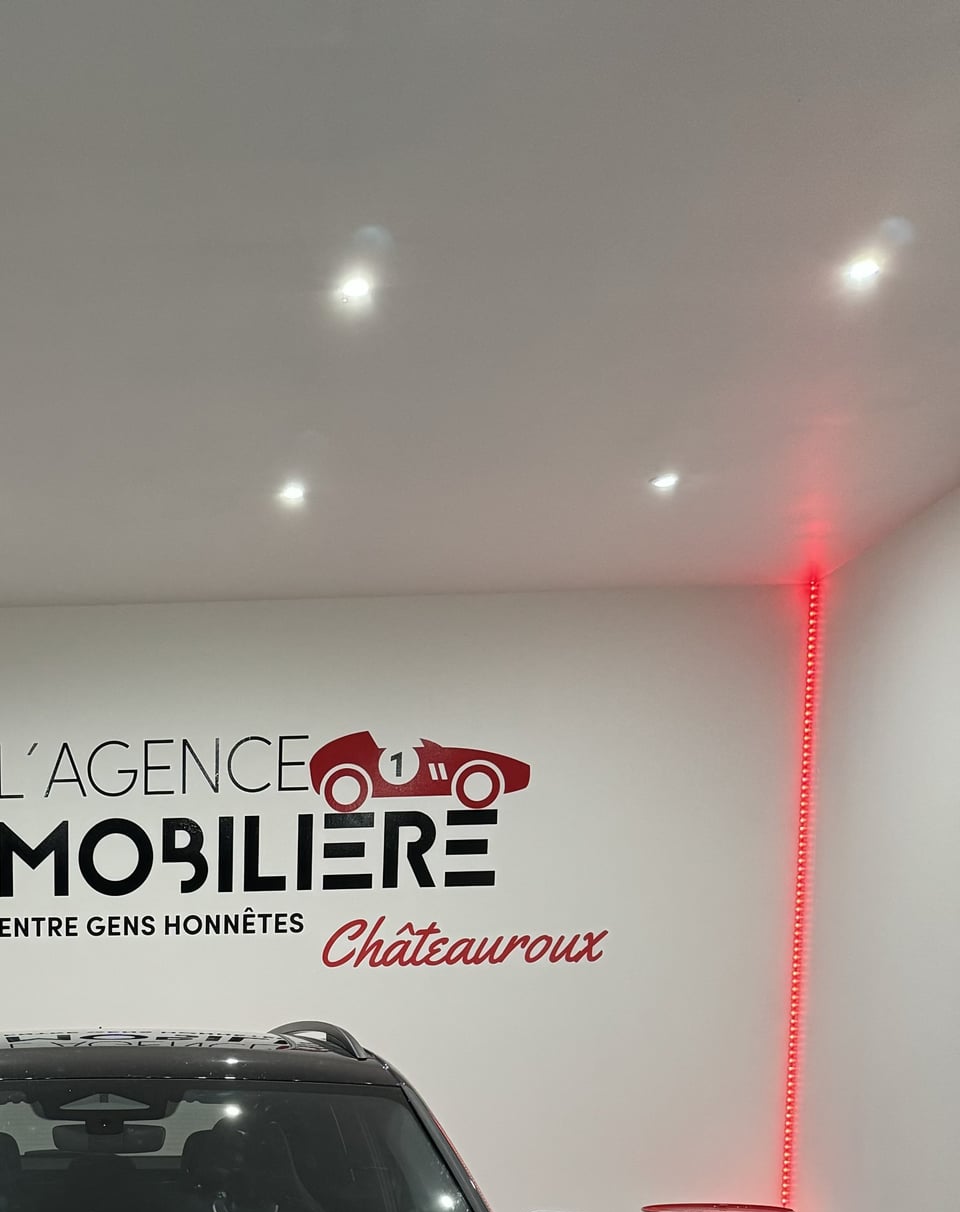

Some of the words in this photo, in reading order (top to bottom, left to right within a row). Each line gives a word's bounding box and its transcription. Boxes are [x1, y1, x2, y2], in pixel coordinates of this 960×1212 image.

[390, 751, 403, 777] 1
[86, 915, 156, 936] GENS
[164, 907, 305, 935] HONNÊTES
[321, 915, 609, 968] Châteauroux
